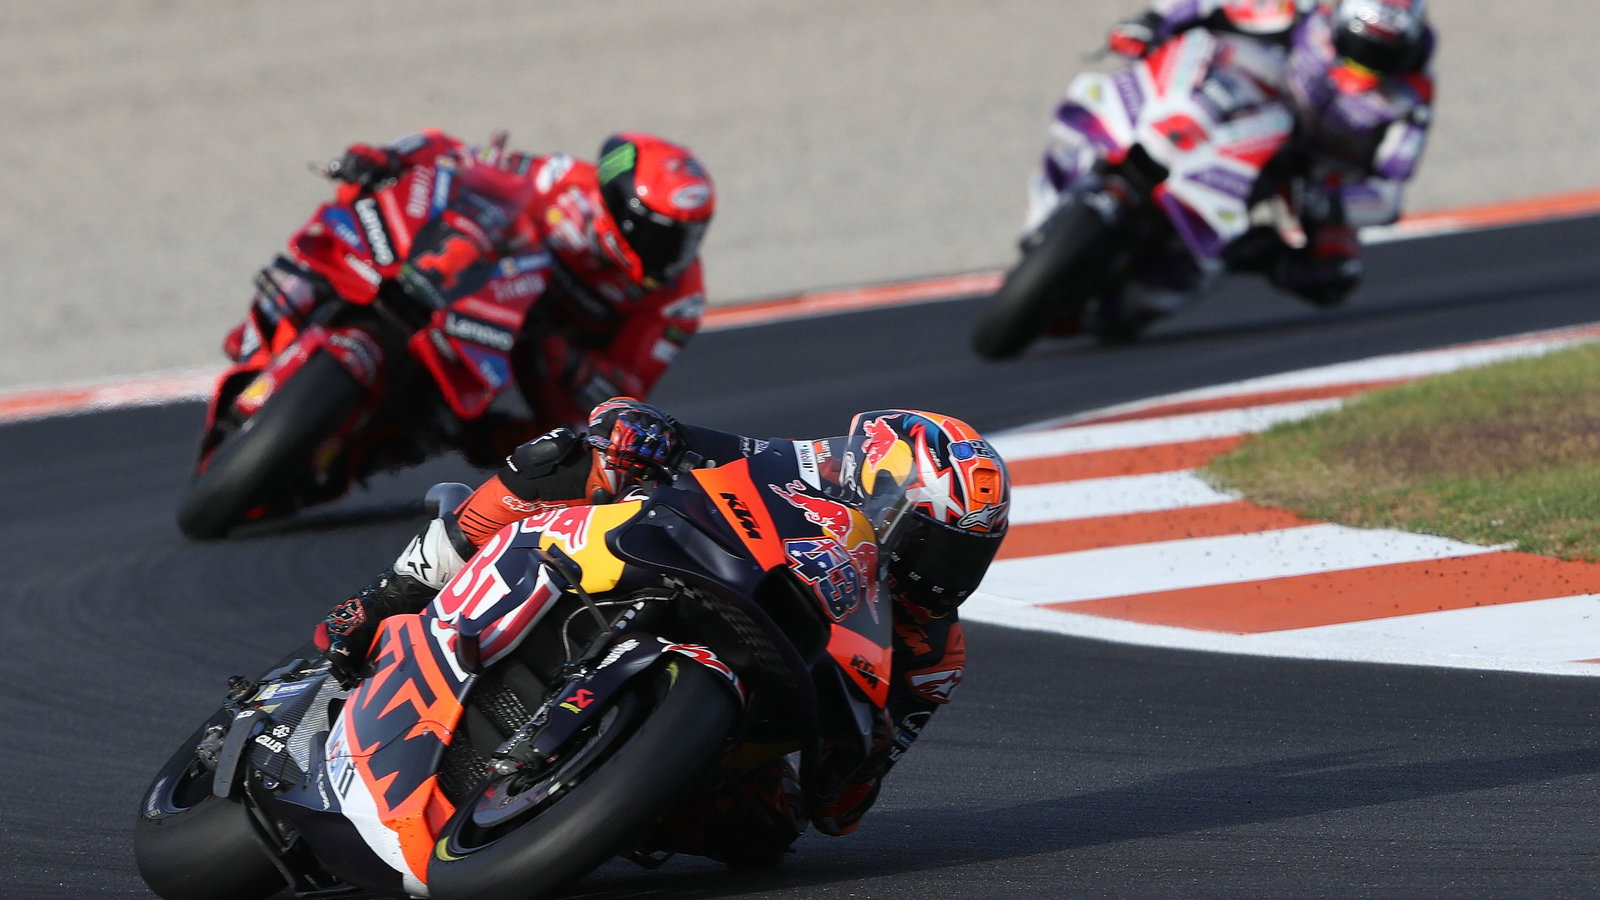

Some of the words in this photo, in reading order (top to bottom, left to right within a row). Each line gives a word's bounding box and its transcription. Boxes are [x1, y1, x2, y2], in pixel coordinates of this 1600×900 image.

[446, 310, 514, 351] Lenovo
[718, 492, 763, 540] KTM
[783, 535, 861, 622] 43
[254, 734, 287, 754] GILLES
